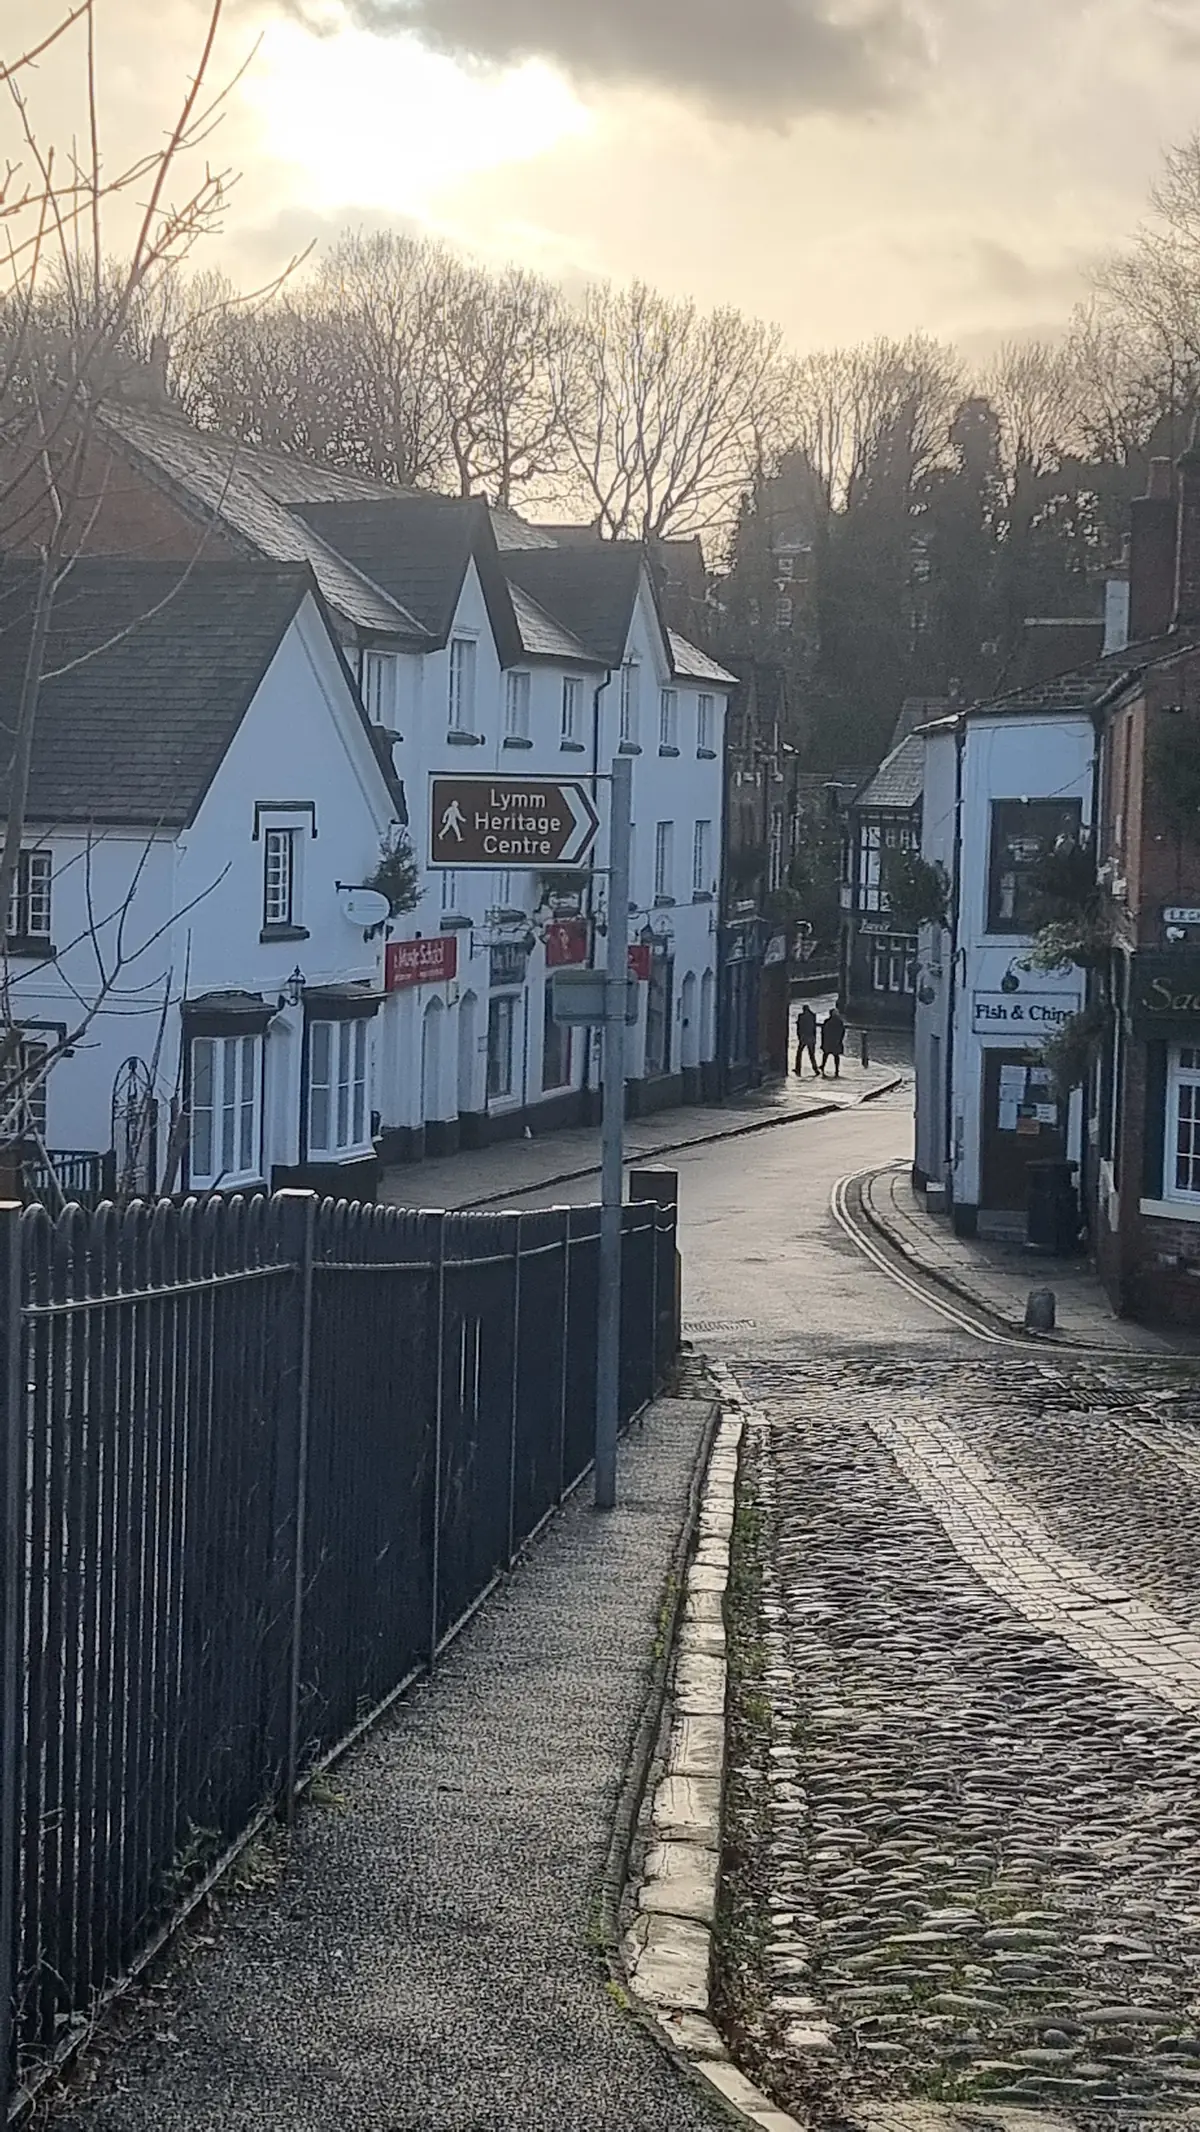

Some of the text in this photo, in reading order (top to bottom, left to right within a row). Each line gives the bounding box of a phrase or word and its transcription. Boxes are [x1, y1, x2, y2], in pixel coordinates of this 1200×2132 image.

[491, 789, 546, 811] Lymm
[475, 812, 561, 834] Heritage
[484, 836, 551, 854] Centre
[975, 1004, 1007, 1020] Fish
[1011, 1005, 1024, 1020] &
